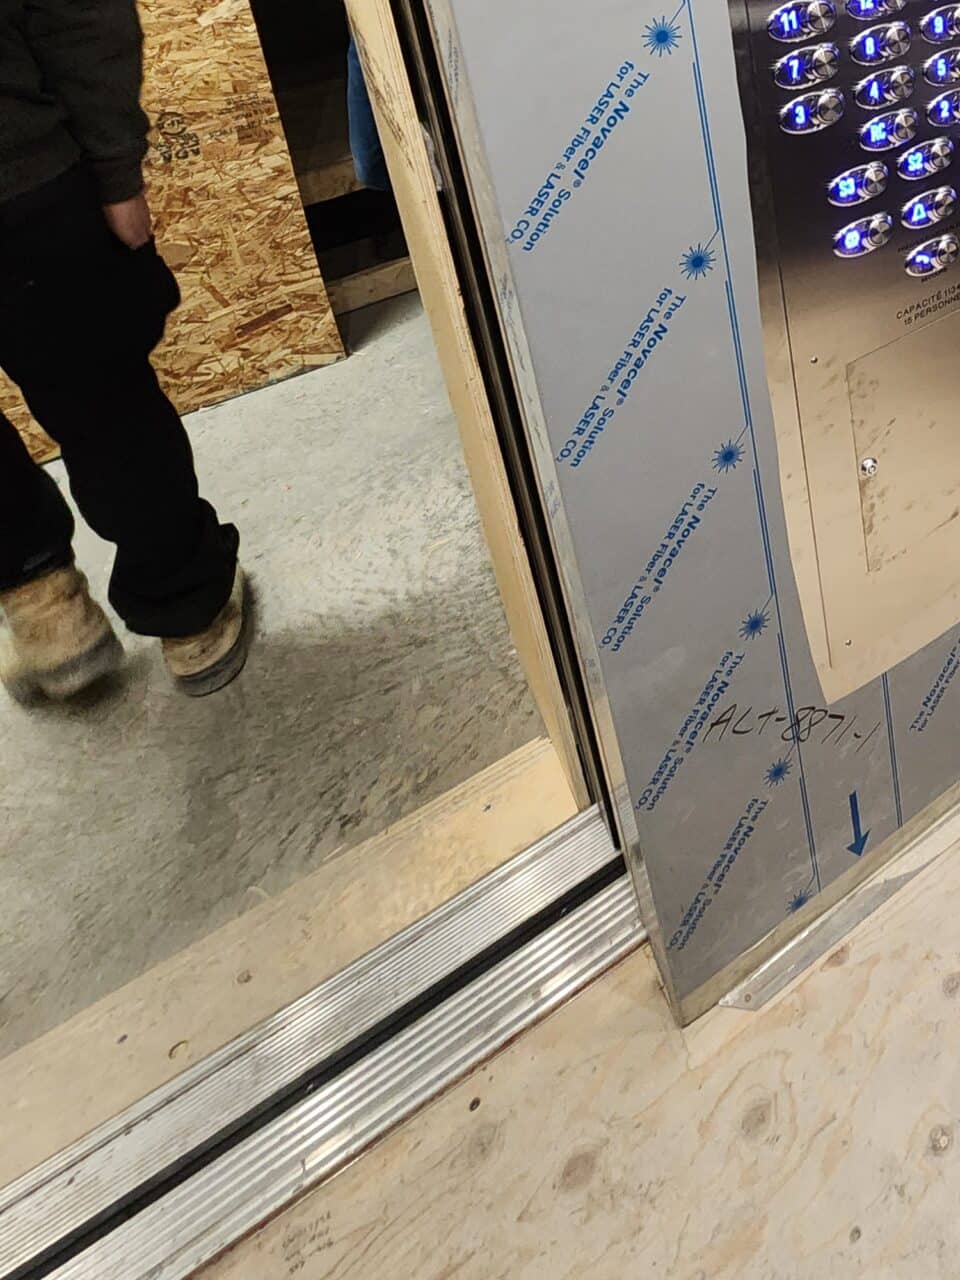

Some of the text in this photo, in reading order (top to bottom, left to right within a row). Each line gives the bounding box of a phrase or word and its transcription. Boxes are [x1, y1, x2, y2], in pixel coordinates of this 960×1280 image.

[780, 11, 799, 32] 11
[934, 15, 944, 34] 9
[616, 60, 635, 82] for
[789, 58, 800, 78] 7
[937, 59, 947, 77] 5
[624, 71, 650, 98] The
[869, 81, 880, 99] 4
[586, 81, 620, 126] LASER
[795, 105, 806, 125] 3
[941, 100, 950, 118] 2
[563, 126, 591, 162] Fiber
[908, 152, 924, 171] S2
[524, 172, 561, 217] LASER
[522, 188, 571, 252] Solution
[656, 287, 673, 307] for
[663, 295, 687, 320] The
[896, 290, 942, 320] CAPACITÉ
[628, 308, 660, 349] LASER
[607, 351, 633, 384] Fiber
[573, 395, 606, 436] LASER
[569, 407, 615, 468] Solution
[696, 487, 718, 512] The
[613, 483, 705, 624] for LASER Fiber LASER
[611, 595, 651, 652] Solution
